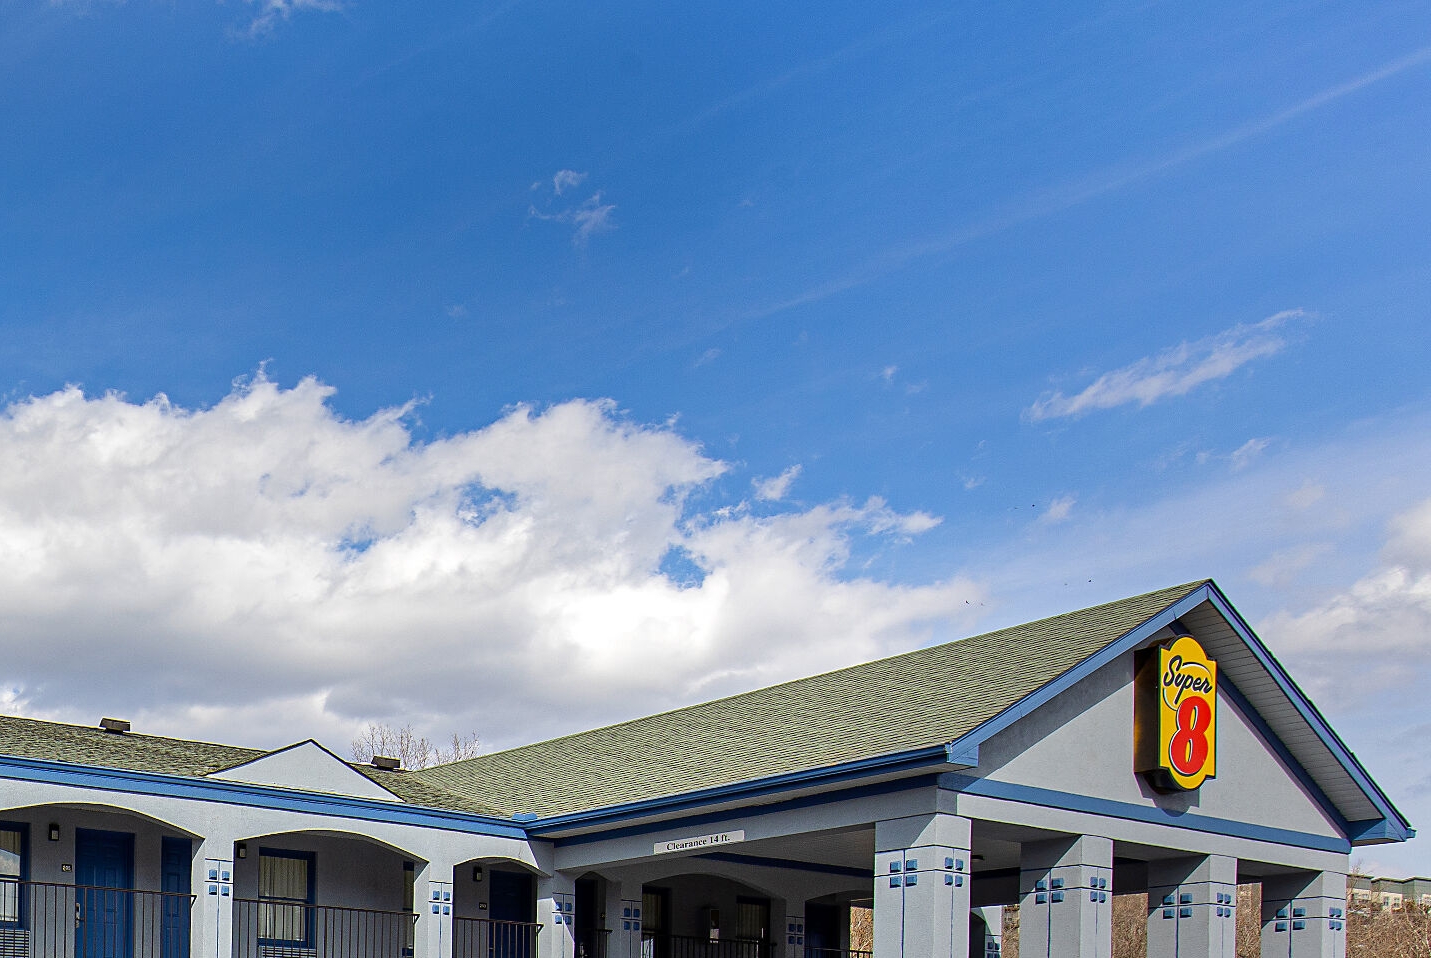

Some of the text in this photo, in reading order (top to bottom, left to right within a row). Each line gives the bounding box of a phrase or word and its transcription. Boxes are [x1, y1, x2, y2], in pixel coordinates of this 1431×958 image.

[1163, 655, 1213, 705] Super
[1168, 696, 1212, 777] 8
[666, 833, 731, 851] Clearance 14 ft.
